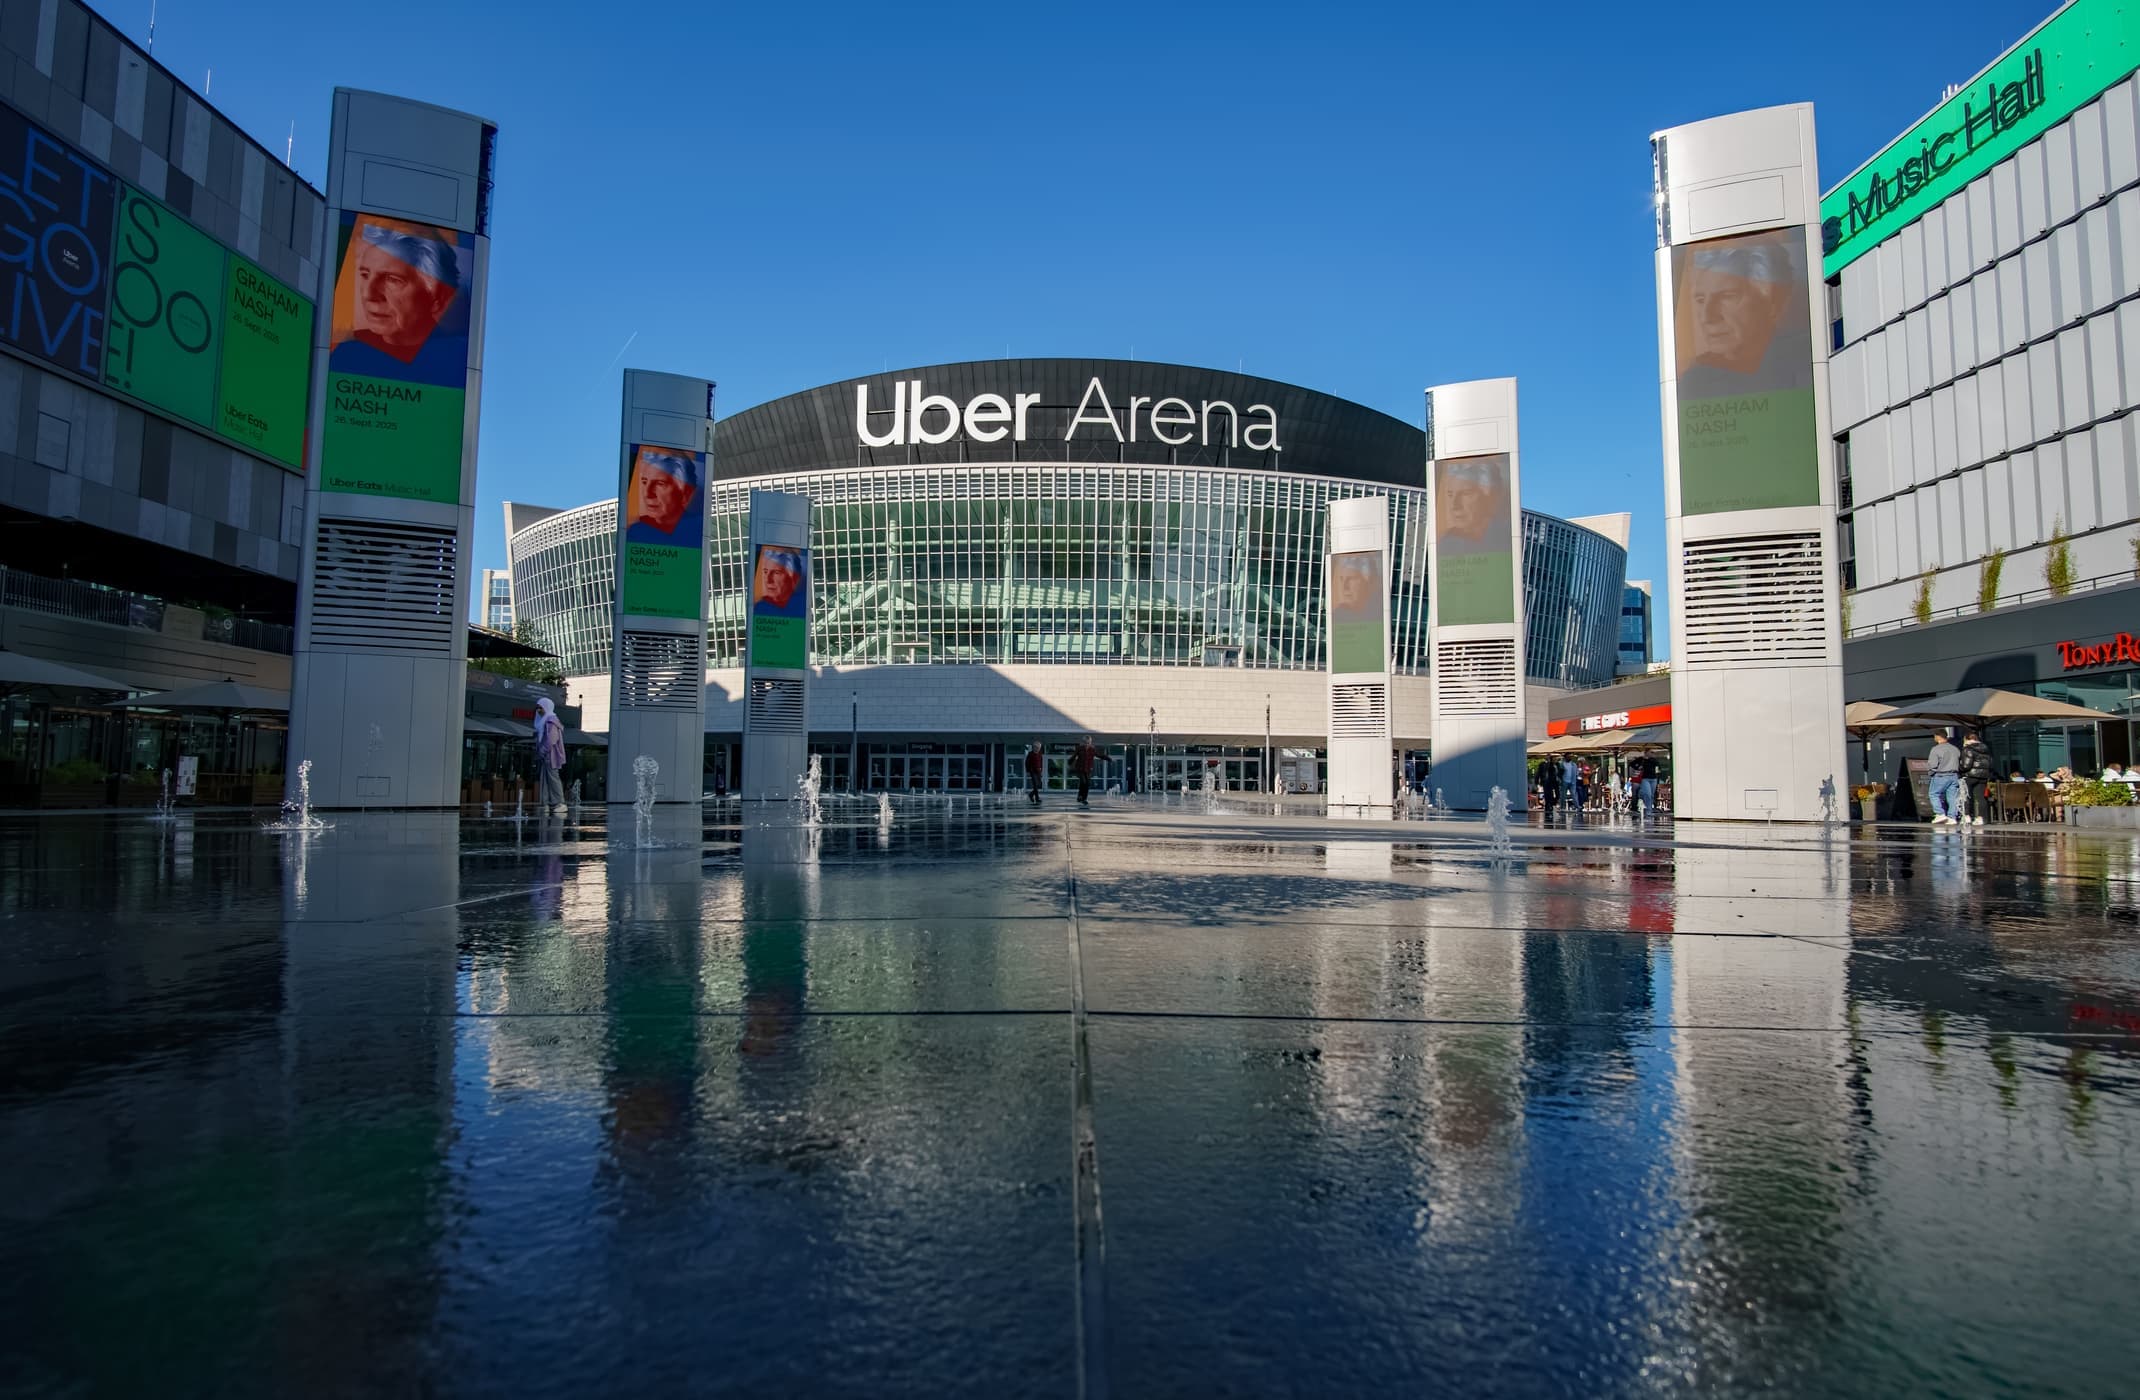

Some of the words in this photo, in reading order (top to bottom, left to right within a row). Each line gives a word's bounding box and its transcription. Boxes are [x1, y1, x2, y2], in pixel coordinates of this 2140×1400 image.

[1849, 137, 1956, 238] Music
[1964, 48, 2046, 156] Hall
[236, 267, 298, 318] GRAHAM
[234, 287, 274, 325] NASH
[335, 378, 422, 403] GRAHAM
[334, 395, 388, 416] NASH
[856, 379, 1040, 447] Uber
[1064, 376, 1282, 452] Arena
[1686, 398, 1769, 418] GRAHAM
[1686, 418, 1737, 436] NASH
[329, 477, 355, 488] Uber
[357, 480, 382, 490] Eats
[630, 546, 678, 559] GRAHAM
[630, 557, 660, 568] NASH
